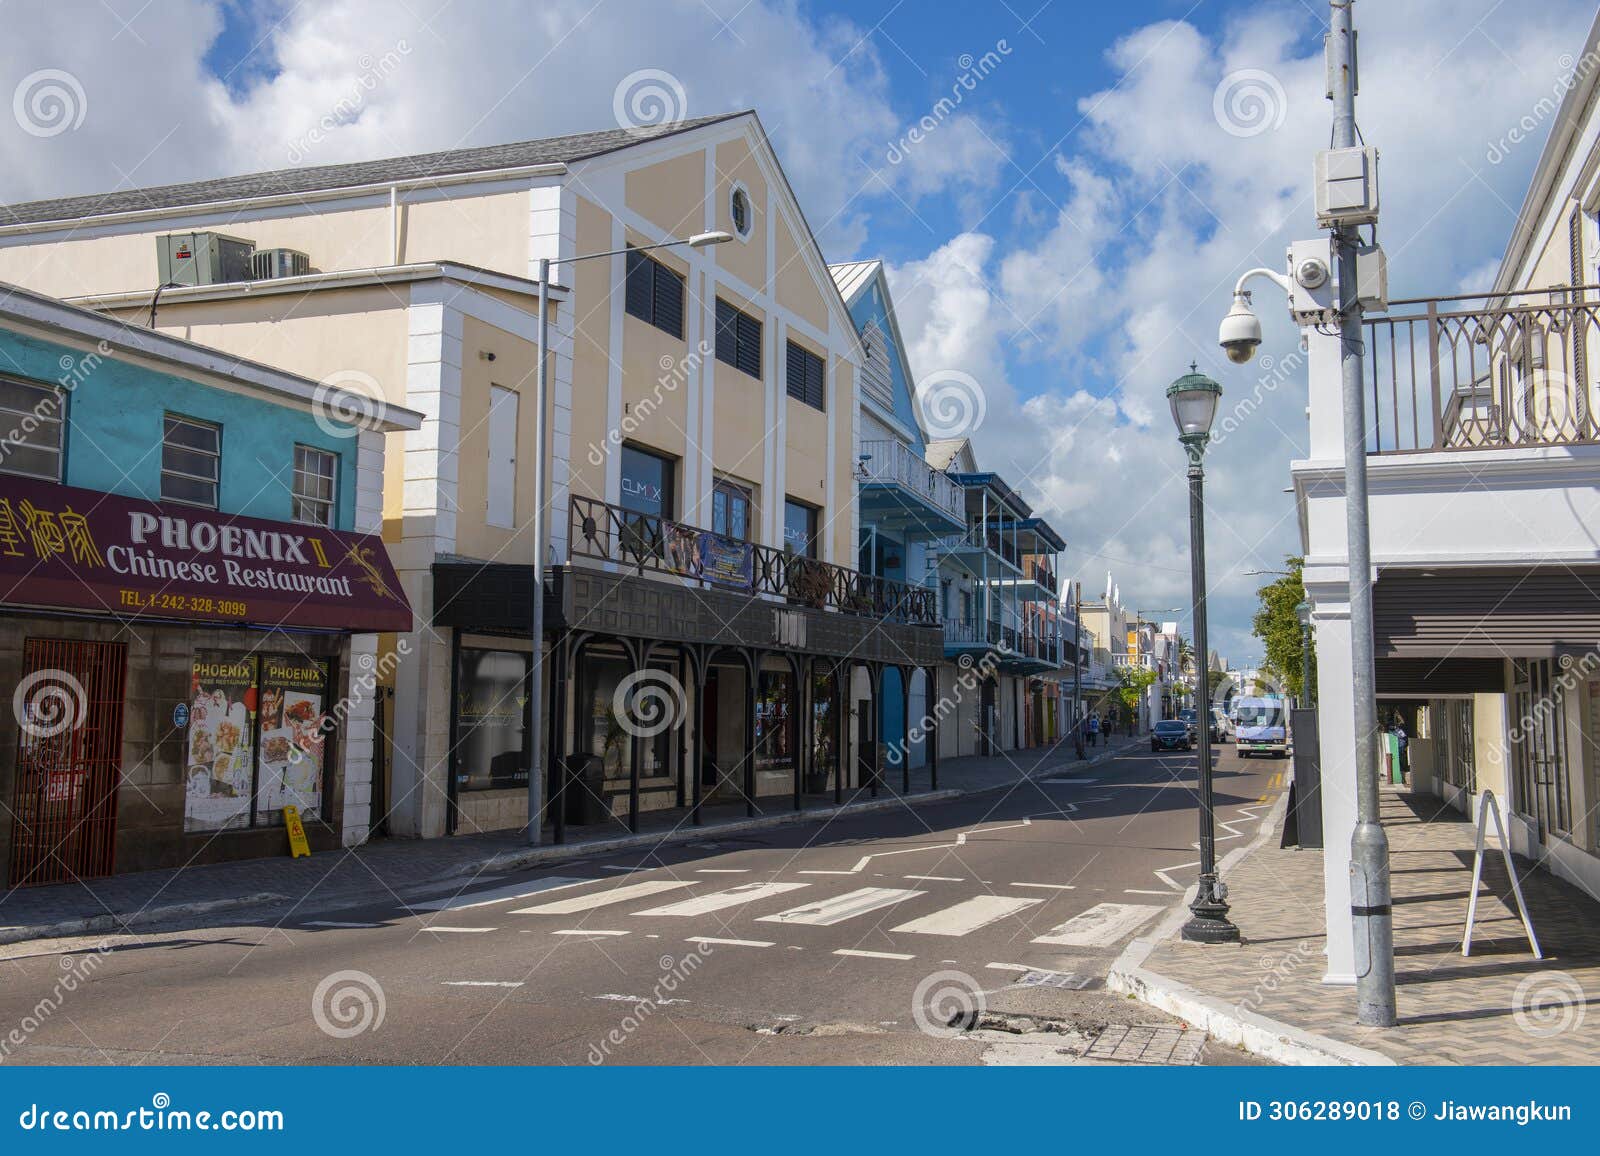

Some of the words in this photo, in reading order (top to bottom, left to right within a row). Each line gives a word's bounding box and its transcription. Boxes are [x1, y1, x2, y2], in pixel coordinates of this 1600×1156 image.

[128, 511, 310, 564] PHOENIX
[107, 545, 219, 584] Chinese
[222, 560, 353, 597] Restaurant
[150, 593, 247, 616] 1-242-328-3099
[193, 663, 250, 678] PHOENIX
[270, 666, 320, 681] PHOENIX
